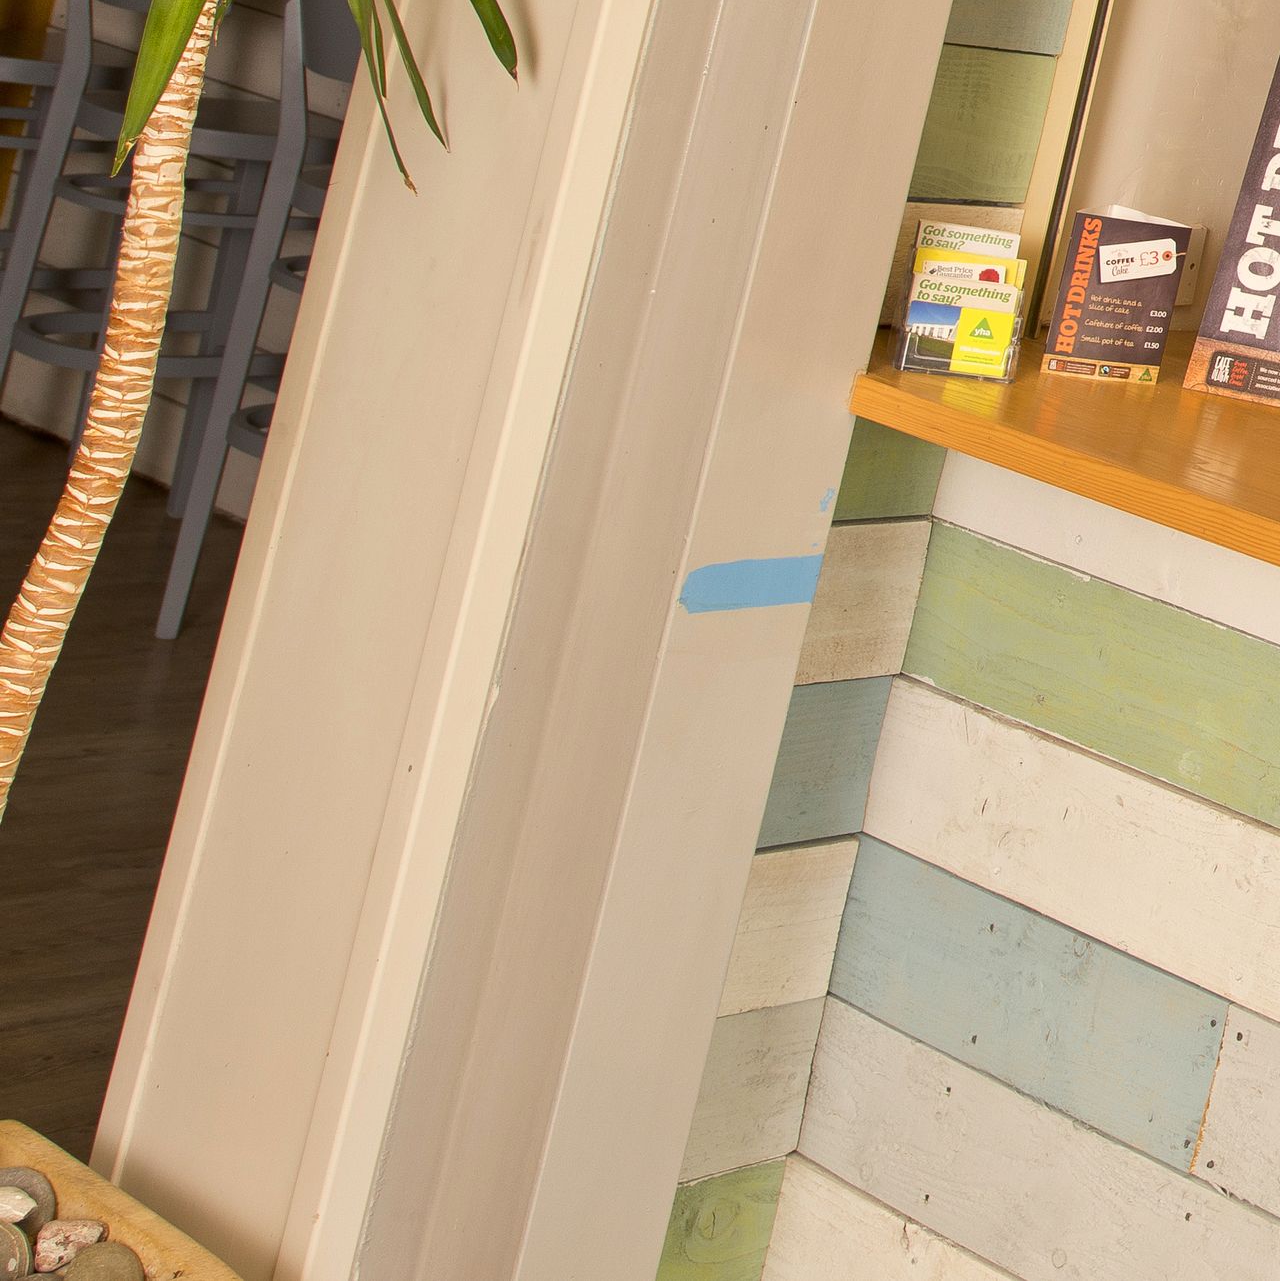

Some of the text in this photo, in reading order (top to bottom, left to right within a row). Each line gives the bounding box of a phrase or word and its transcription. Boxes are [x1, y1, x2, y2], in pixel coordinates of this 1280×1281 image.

[920, 235, 965, 251] to say?
[923, 224, 1014, 249] Got something
[1066, 217, 1103, 304] DRINKS
[1105, 257, 1135, 266] COFFEE
[1139, 250, 1159, 267] £3
[954, 266, 974, 275] Price
[1111, 266, 1129, 277] Cake
[916, 290, 962, 306] to say?
[919, 279, 1012, 304] Got something
[1102, 295, 1122, 305] drink
[1122, 298, 1137, 307] and
[1088, 303, 1167, 318] slice of cake £3.00
[974, 328, 991, 337] yha
[1055, 303, 1082, 354] HOT
[1114, 322, 1123, 330] of
[1145, 325, 1164, 334] £2.00
[1080, 334, 1101, 344] Small
[1101, 337, 1114, 347] pot
[1114, 338, 1123, 347] of
[1124, 339, 1135, 348] tea
